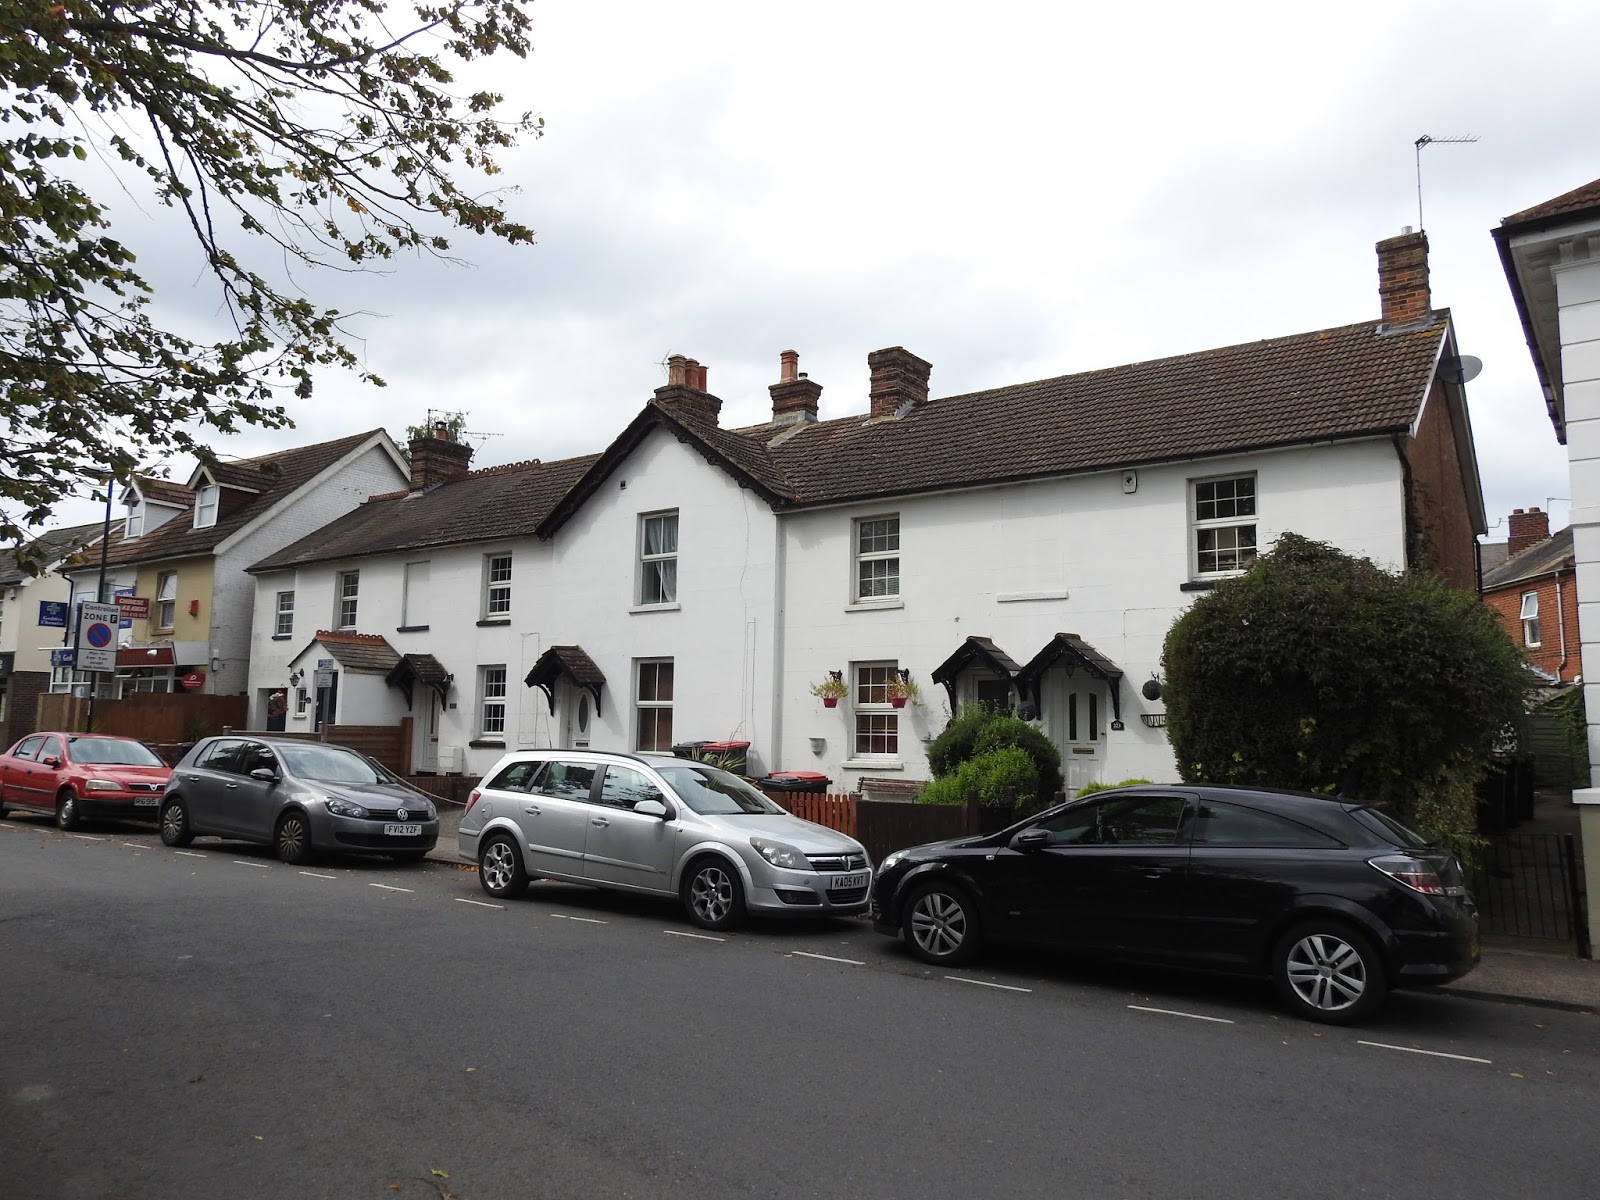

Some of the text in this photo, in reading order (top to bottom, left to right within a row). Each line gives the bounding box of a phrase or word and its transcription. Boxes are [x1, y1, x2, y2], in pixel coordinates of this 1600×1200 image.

[85, 604, 119, 613] Controlled
[84, 613, 108, 621] ZONE
[388, 825, 418, 834] FV12 YZF
[835, 876, 852, 887] KA05
